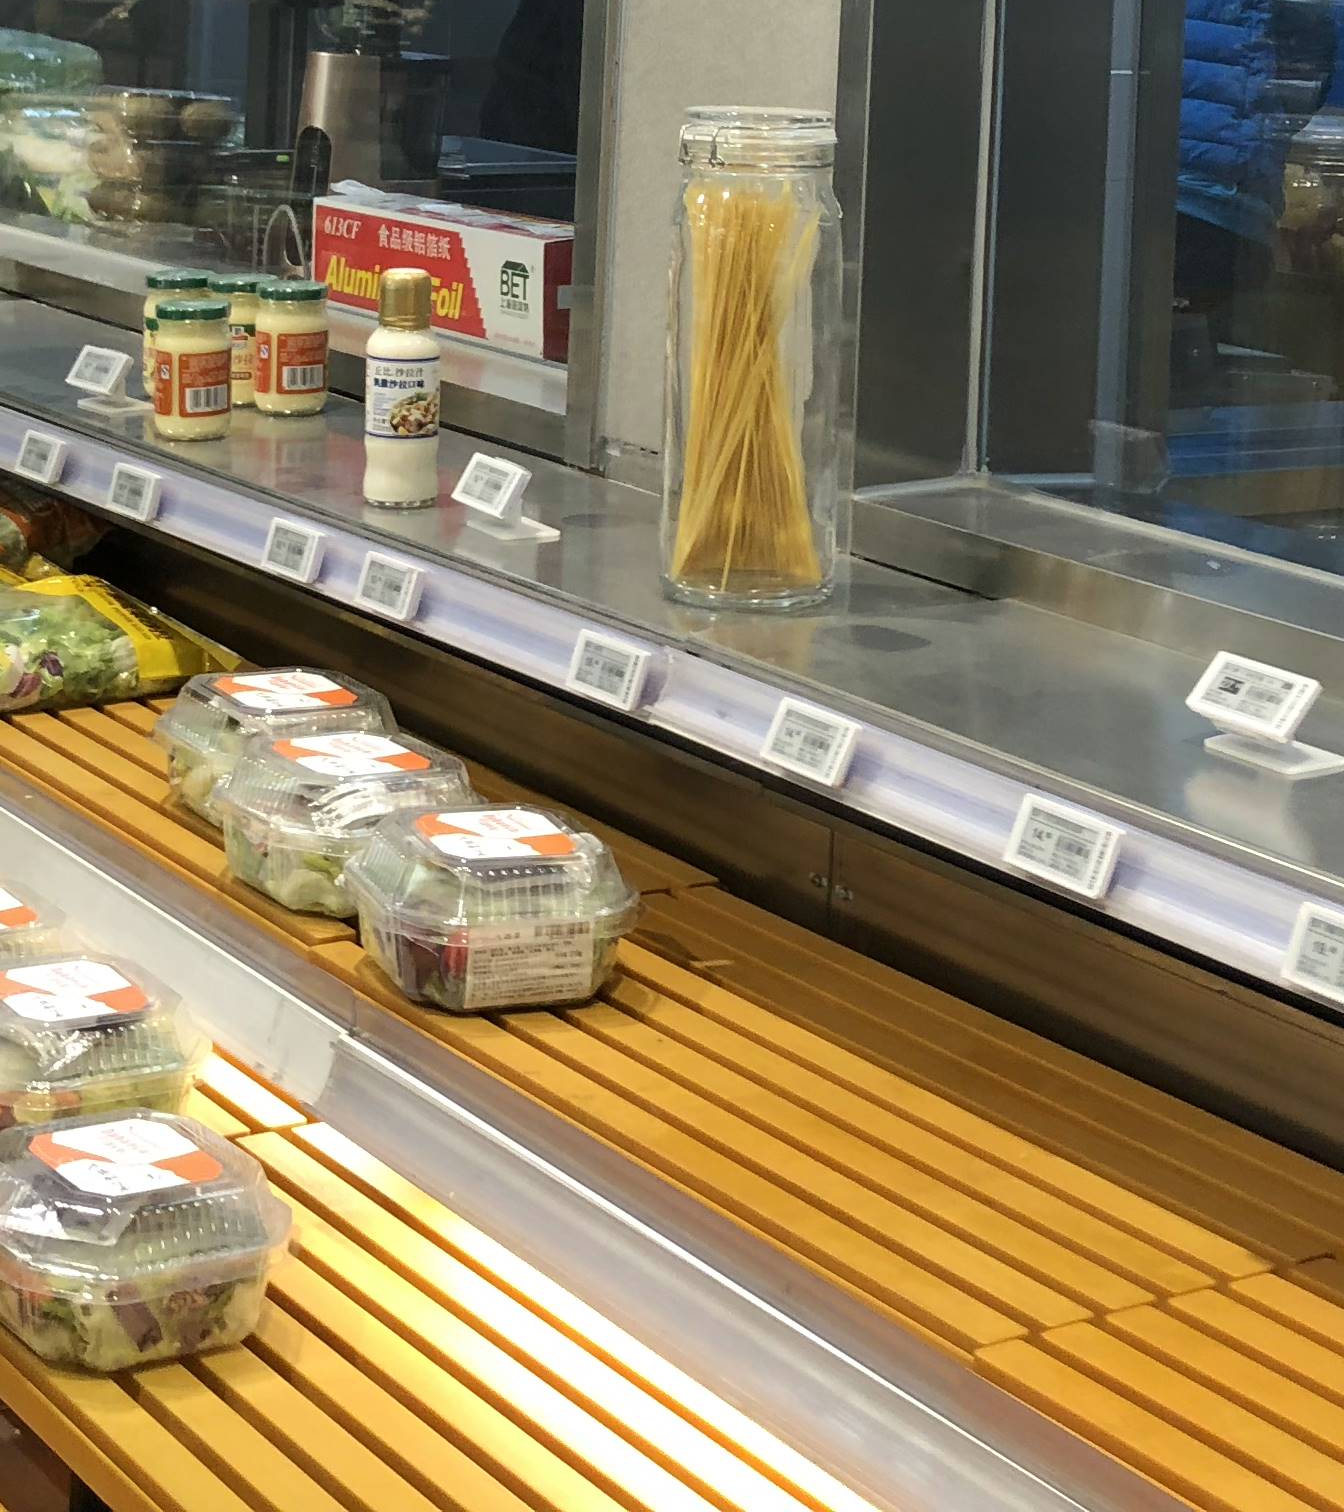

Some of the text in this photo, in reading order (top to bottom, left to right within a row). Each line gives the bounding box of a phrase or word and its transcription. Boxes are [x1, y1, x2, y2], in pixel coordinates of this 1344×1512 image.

[323, 215, 362, 240] 613CF
[378, 223, 452, 260] 食品级铝箔纸
[325, 255, 381, 300] Alumi
[499, 268, 530, 301] BET
